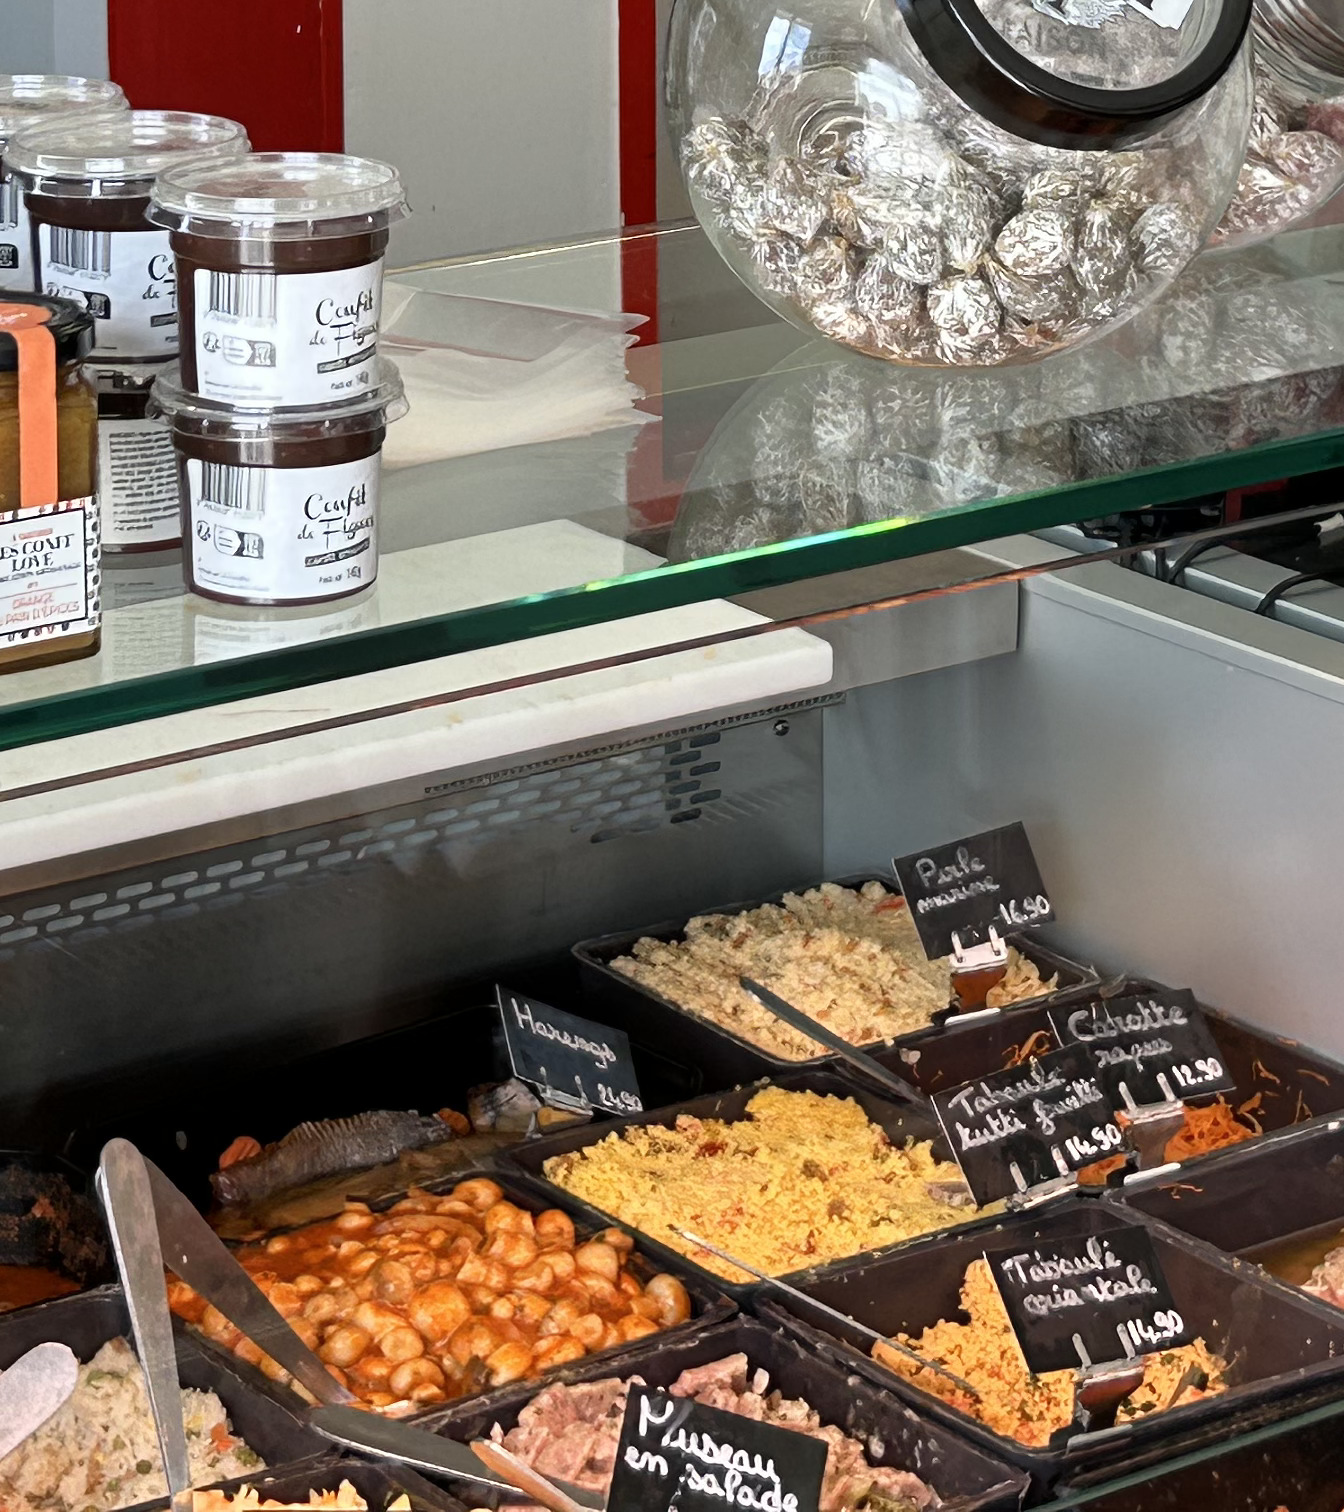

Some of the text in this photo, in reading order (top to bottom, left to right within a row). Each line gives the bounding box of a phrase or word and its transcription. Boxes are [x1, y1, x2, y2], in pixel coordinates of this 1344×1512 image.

[315, 289, 374, 326] Confit
[309, 330, 329, 347] de
[303, 483, 367, 521] Confit
[297, 524, 315, 541] de
[12, 552, 54, 573] LOVE
[637, 1394, 781, 1486] Museau
[623, 1445, 800, 1512] en salade
